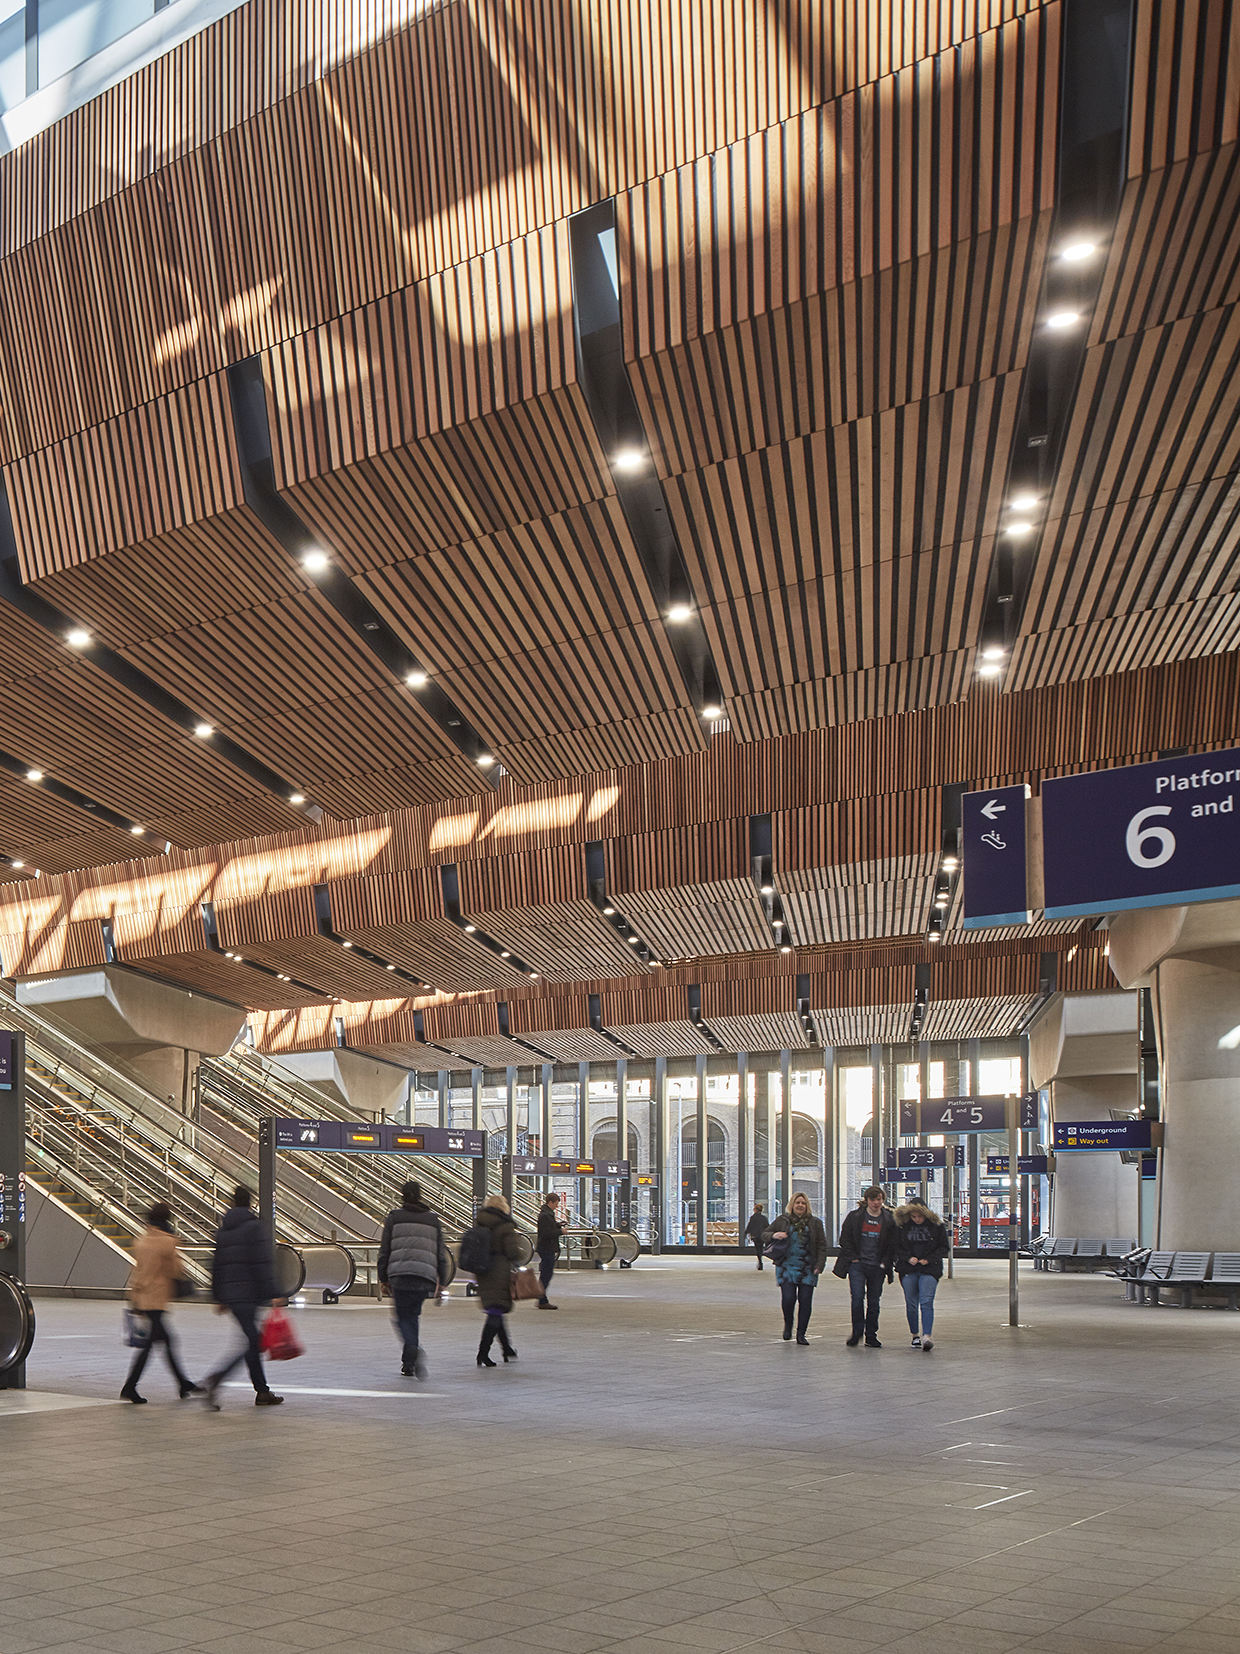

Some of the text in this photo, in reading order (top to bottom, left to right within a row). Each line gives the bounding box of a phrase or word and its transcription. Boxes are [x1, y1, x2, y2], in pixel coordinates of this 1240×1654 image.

[1126, 794, 1234, 869] 6 and
[940, 1108, 954, 1125] 4
[970, 1107, 983, 1124] 5
[910, 1153, 918, 1164] 2
[926, 1152, 935, 1163] 3
[901, 1171, 907, 1180] 1
